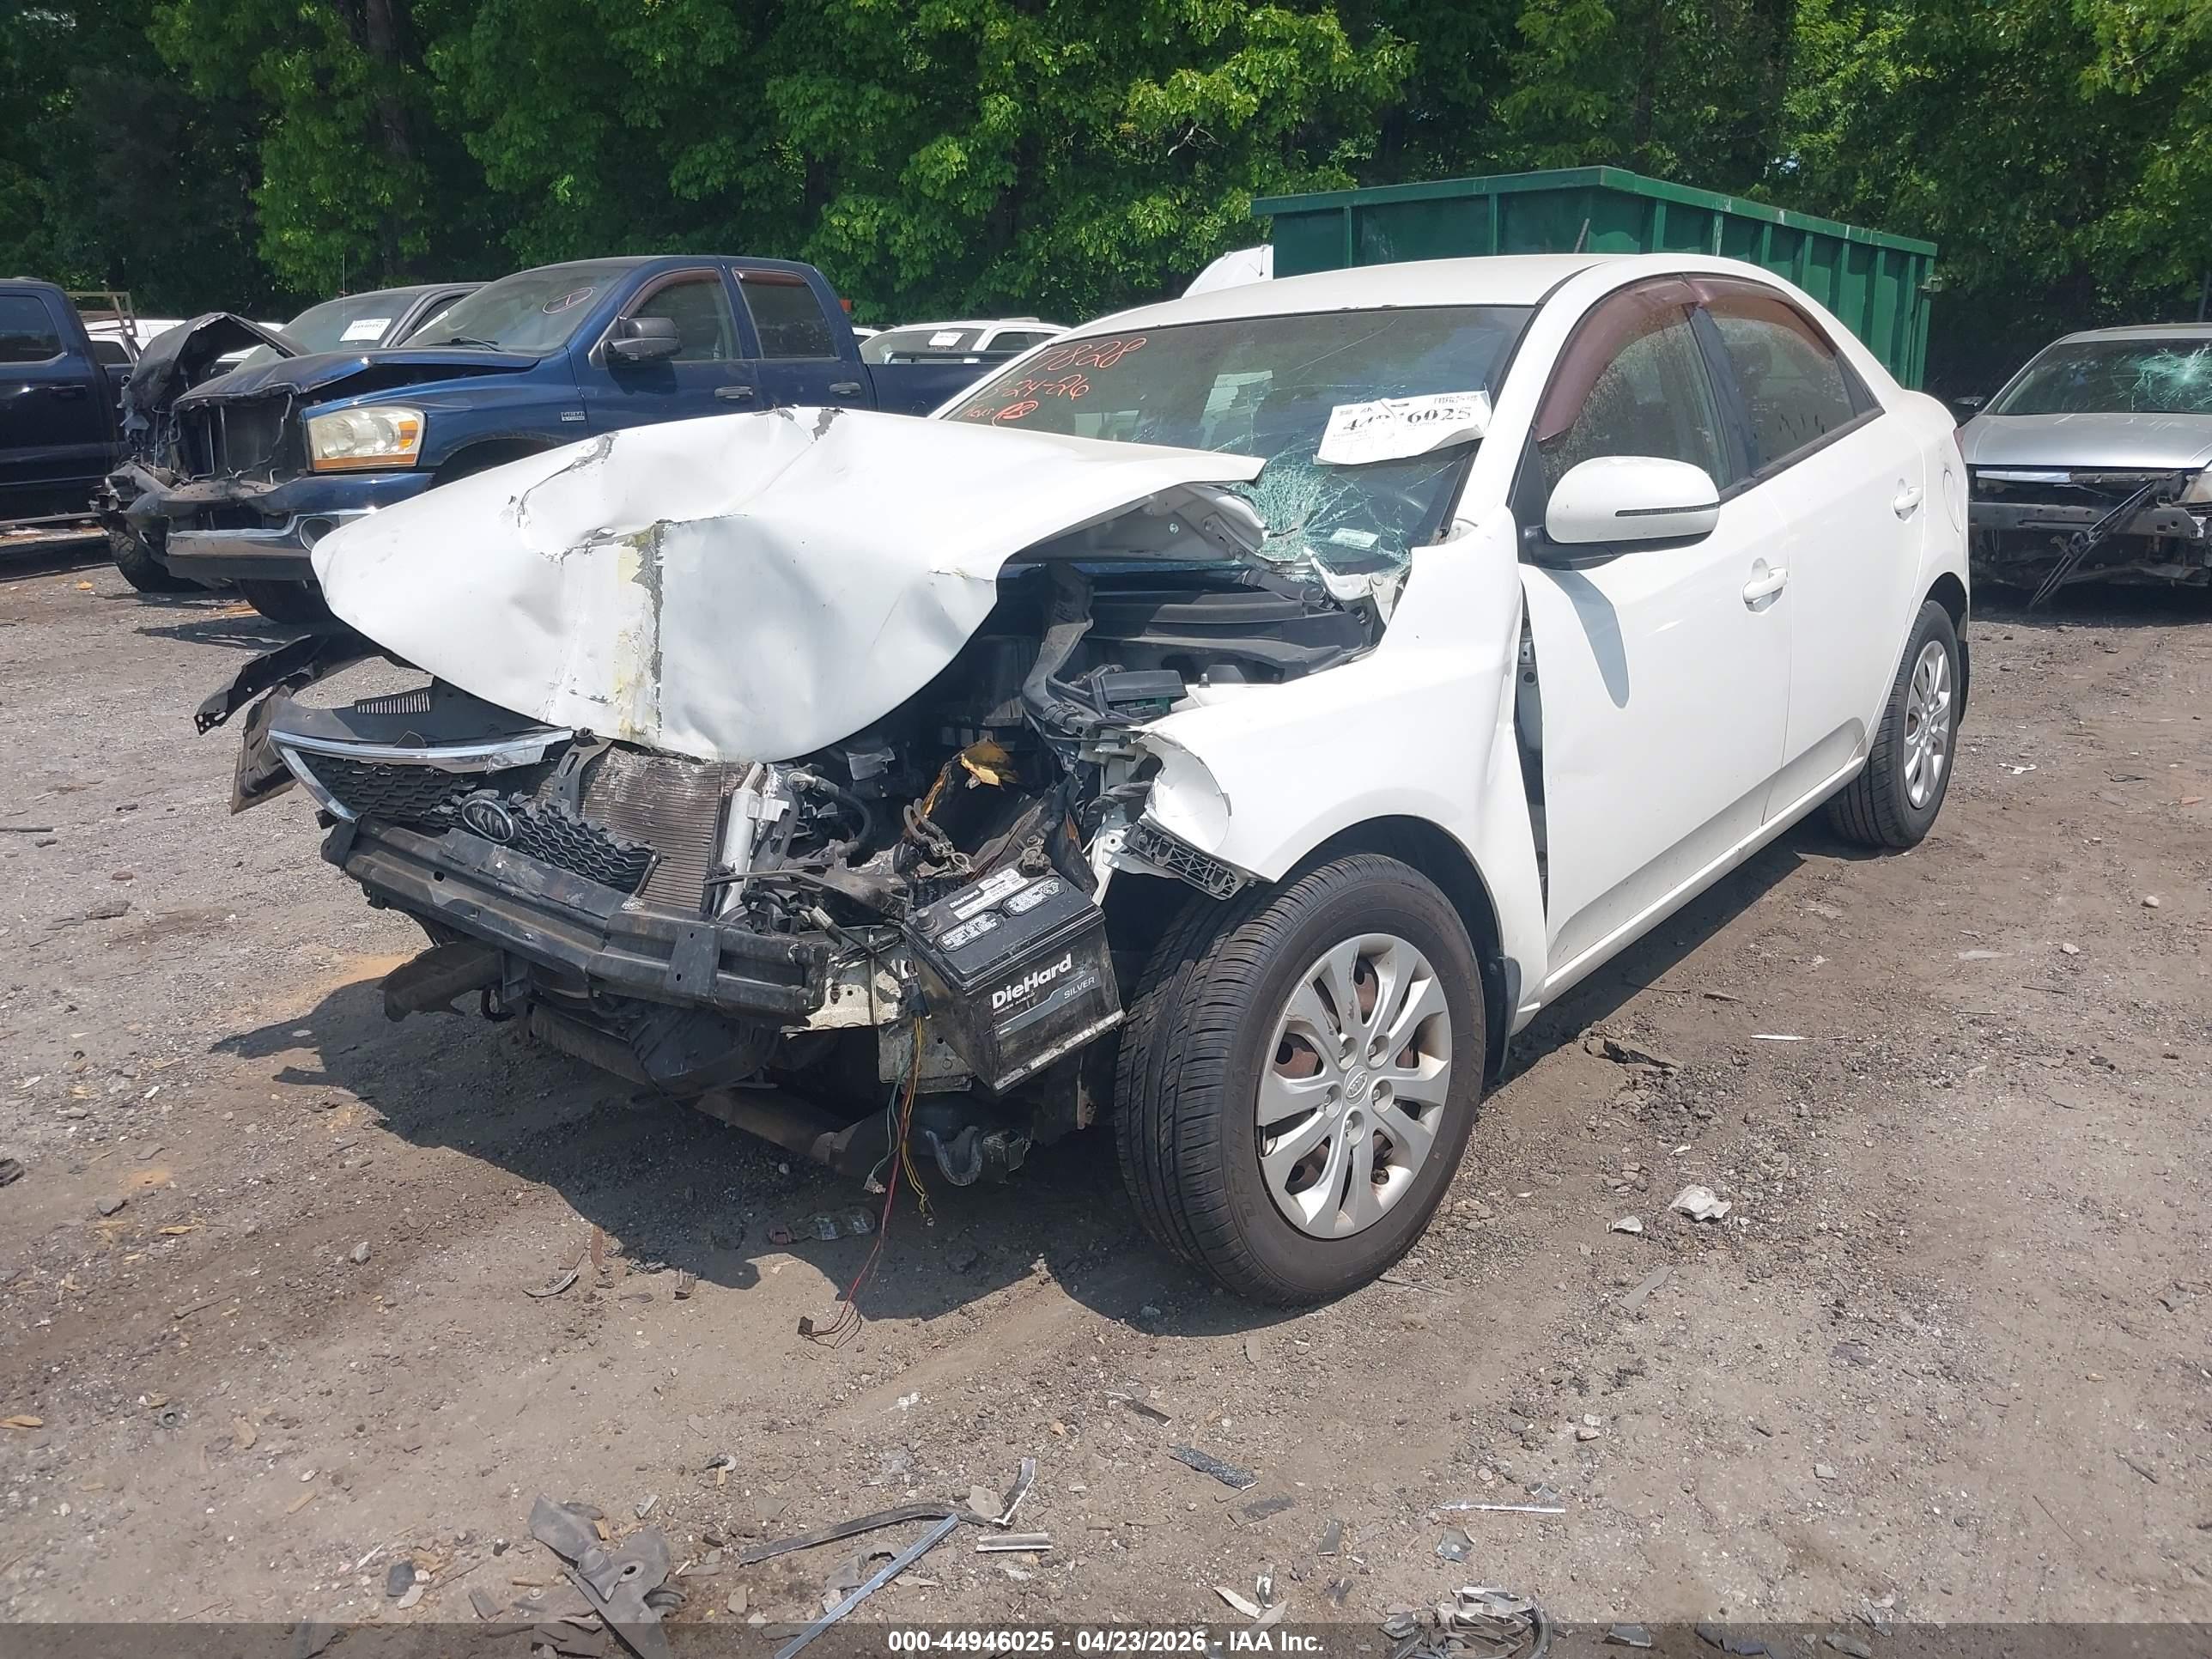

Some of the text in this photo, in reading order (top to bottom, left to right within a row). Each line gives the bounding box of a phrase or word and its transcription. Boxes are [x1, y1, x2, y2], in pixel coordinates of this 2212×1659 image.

[1025, 337, 1147, 375] 7828
[1342, 406, 1472, 431] 446025
[949, 889, 981, 908] DieHard
[992, 953, 1072, 1009] DieHard
[1064, 976, 1096, 1000] SILVER
